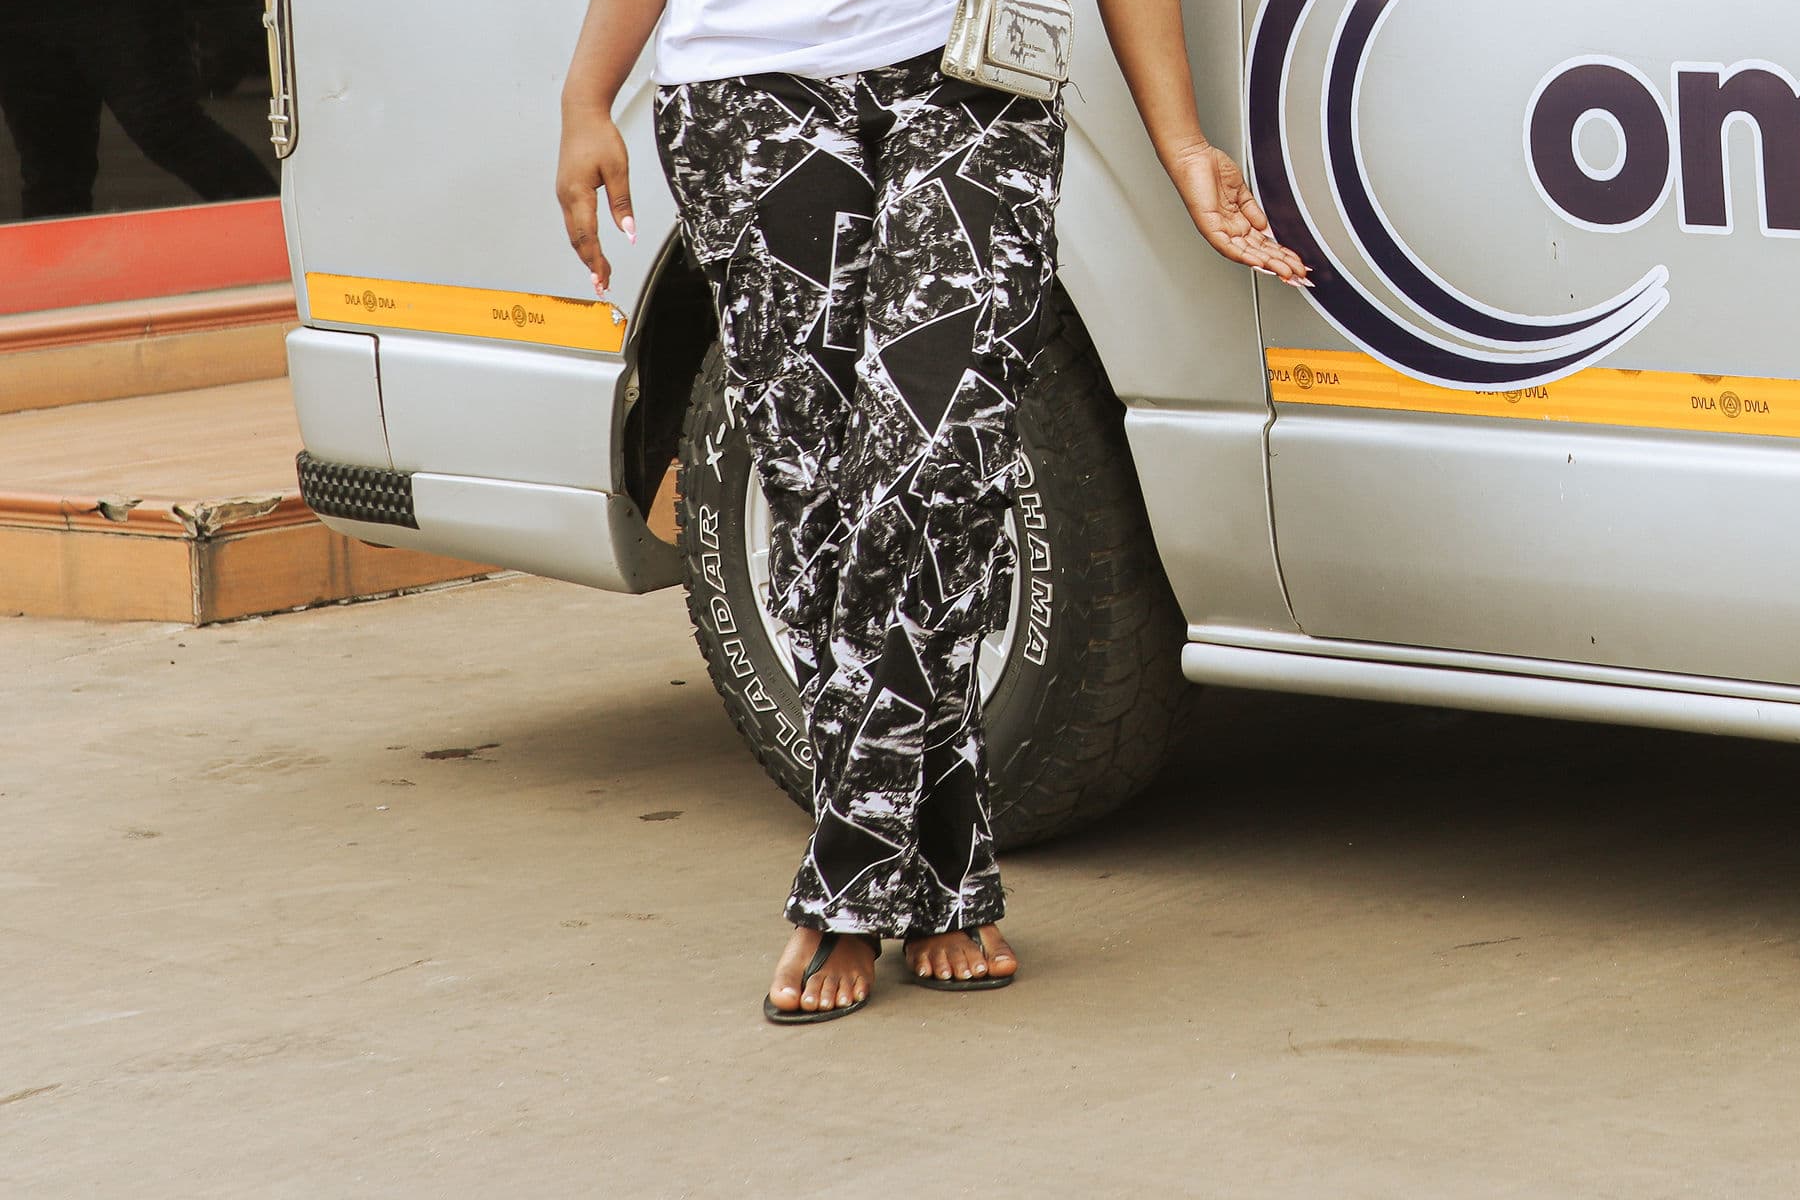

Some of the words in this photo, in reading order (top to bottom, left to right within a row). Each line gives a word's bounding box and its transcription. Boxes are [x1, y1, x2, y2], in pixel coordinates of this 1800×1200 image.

[1268, 368, 1291, 382] DVLA
[1316, 371, 1340, 385] DVLA
[1691, 396, 1717, 410] DVLA
[1744, 399, 1770, 414] DVLA
[698, 505, 816, 770] OLANDAR
